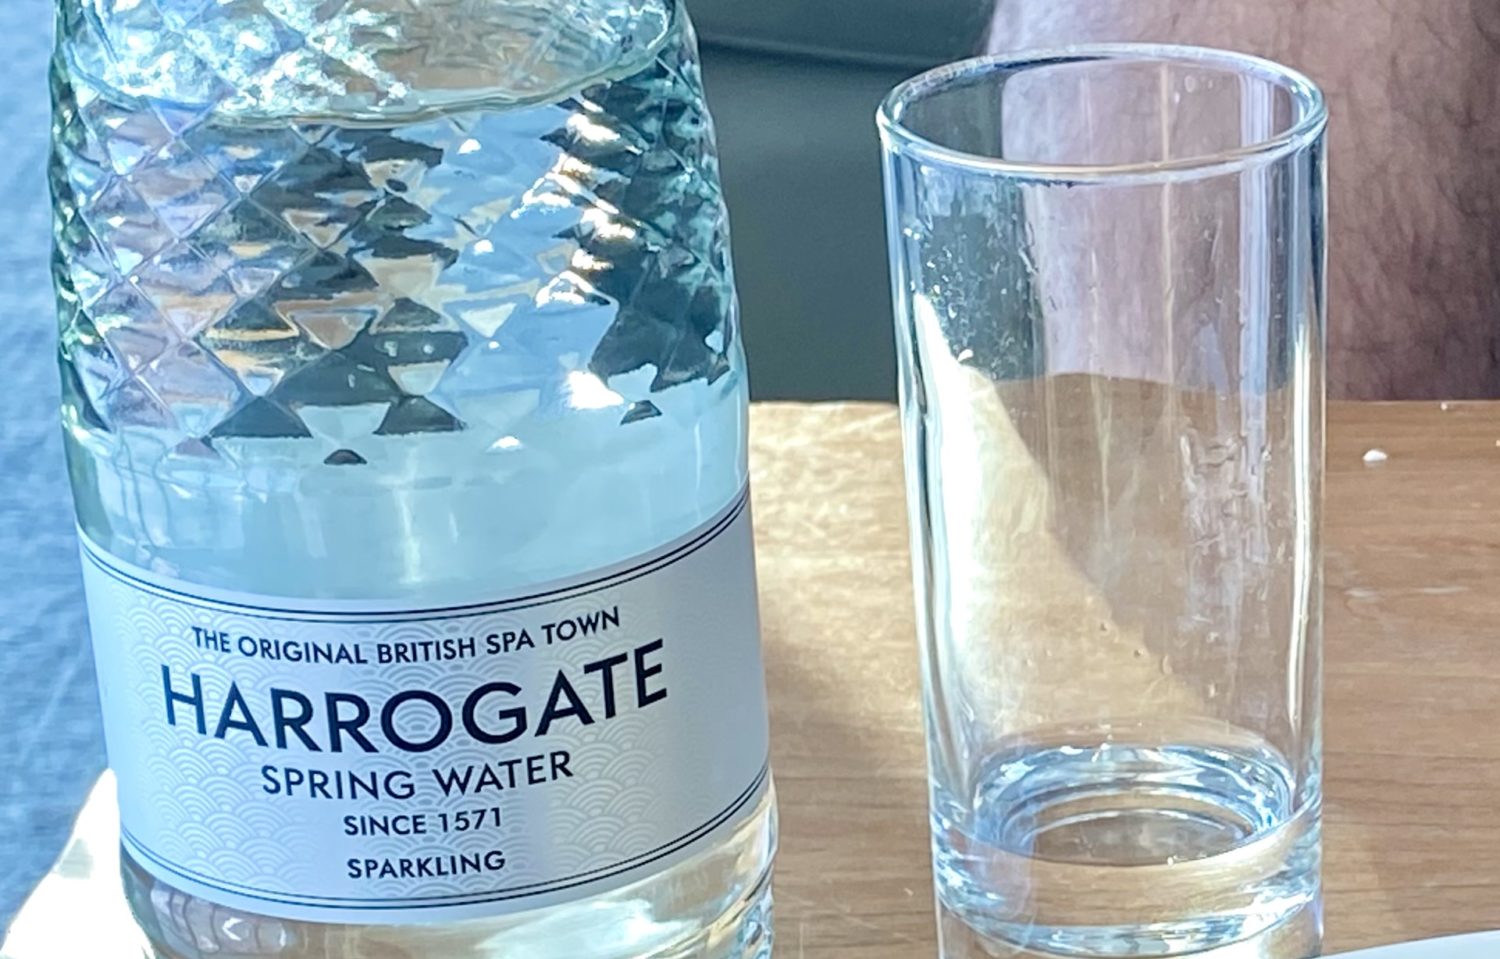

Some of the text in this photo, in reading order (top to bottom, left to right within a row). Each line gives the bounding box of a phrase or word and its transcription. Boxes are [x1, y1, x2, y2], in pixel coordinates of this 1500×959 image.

[191, 606, 620, 665] THE ORIGINAL BRITISH SPA TOWN
[161, 638, 668, 754] HARROGATE
[260, 751, 574, 801] SPRING WATER
[343, 807, 501, 836] SINCE 1571
[347, 850, 506, 879] SPARKLING
